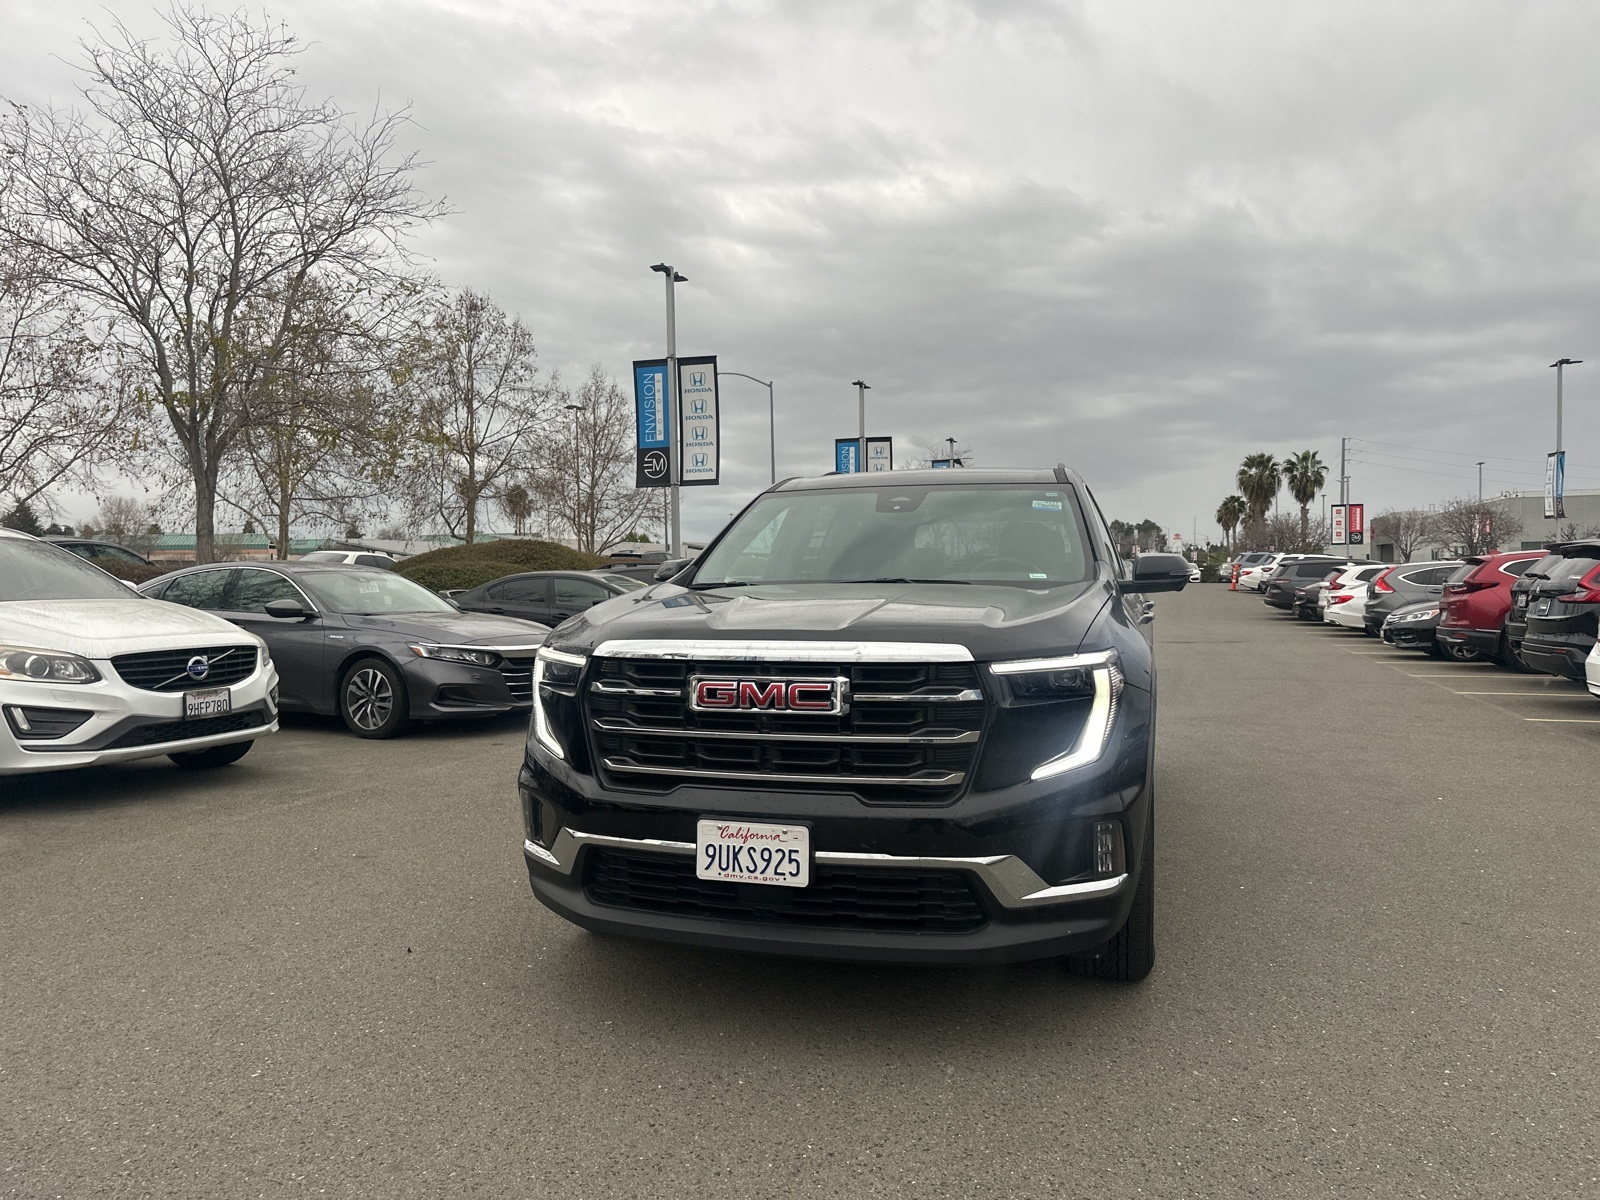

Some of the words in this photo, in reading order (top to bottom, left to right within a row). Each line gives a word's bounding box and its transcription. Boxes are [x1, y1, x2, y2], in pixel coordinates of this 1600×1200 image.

[643, 373, 656, 442] ENVISION
[188, 699, 228, 715] 9HFP780
[698, 681, 832, 710] GMC
[720, 825, 788, 844] California
[704, 843, 801, 877] 9UKS925
[724, 872, 780, 882] dmv.ca.gov
